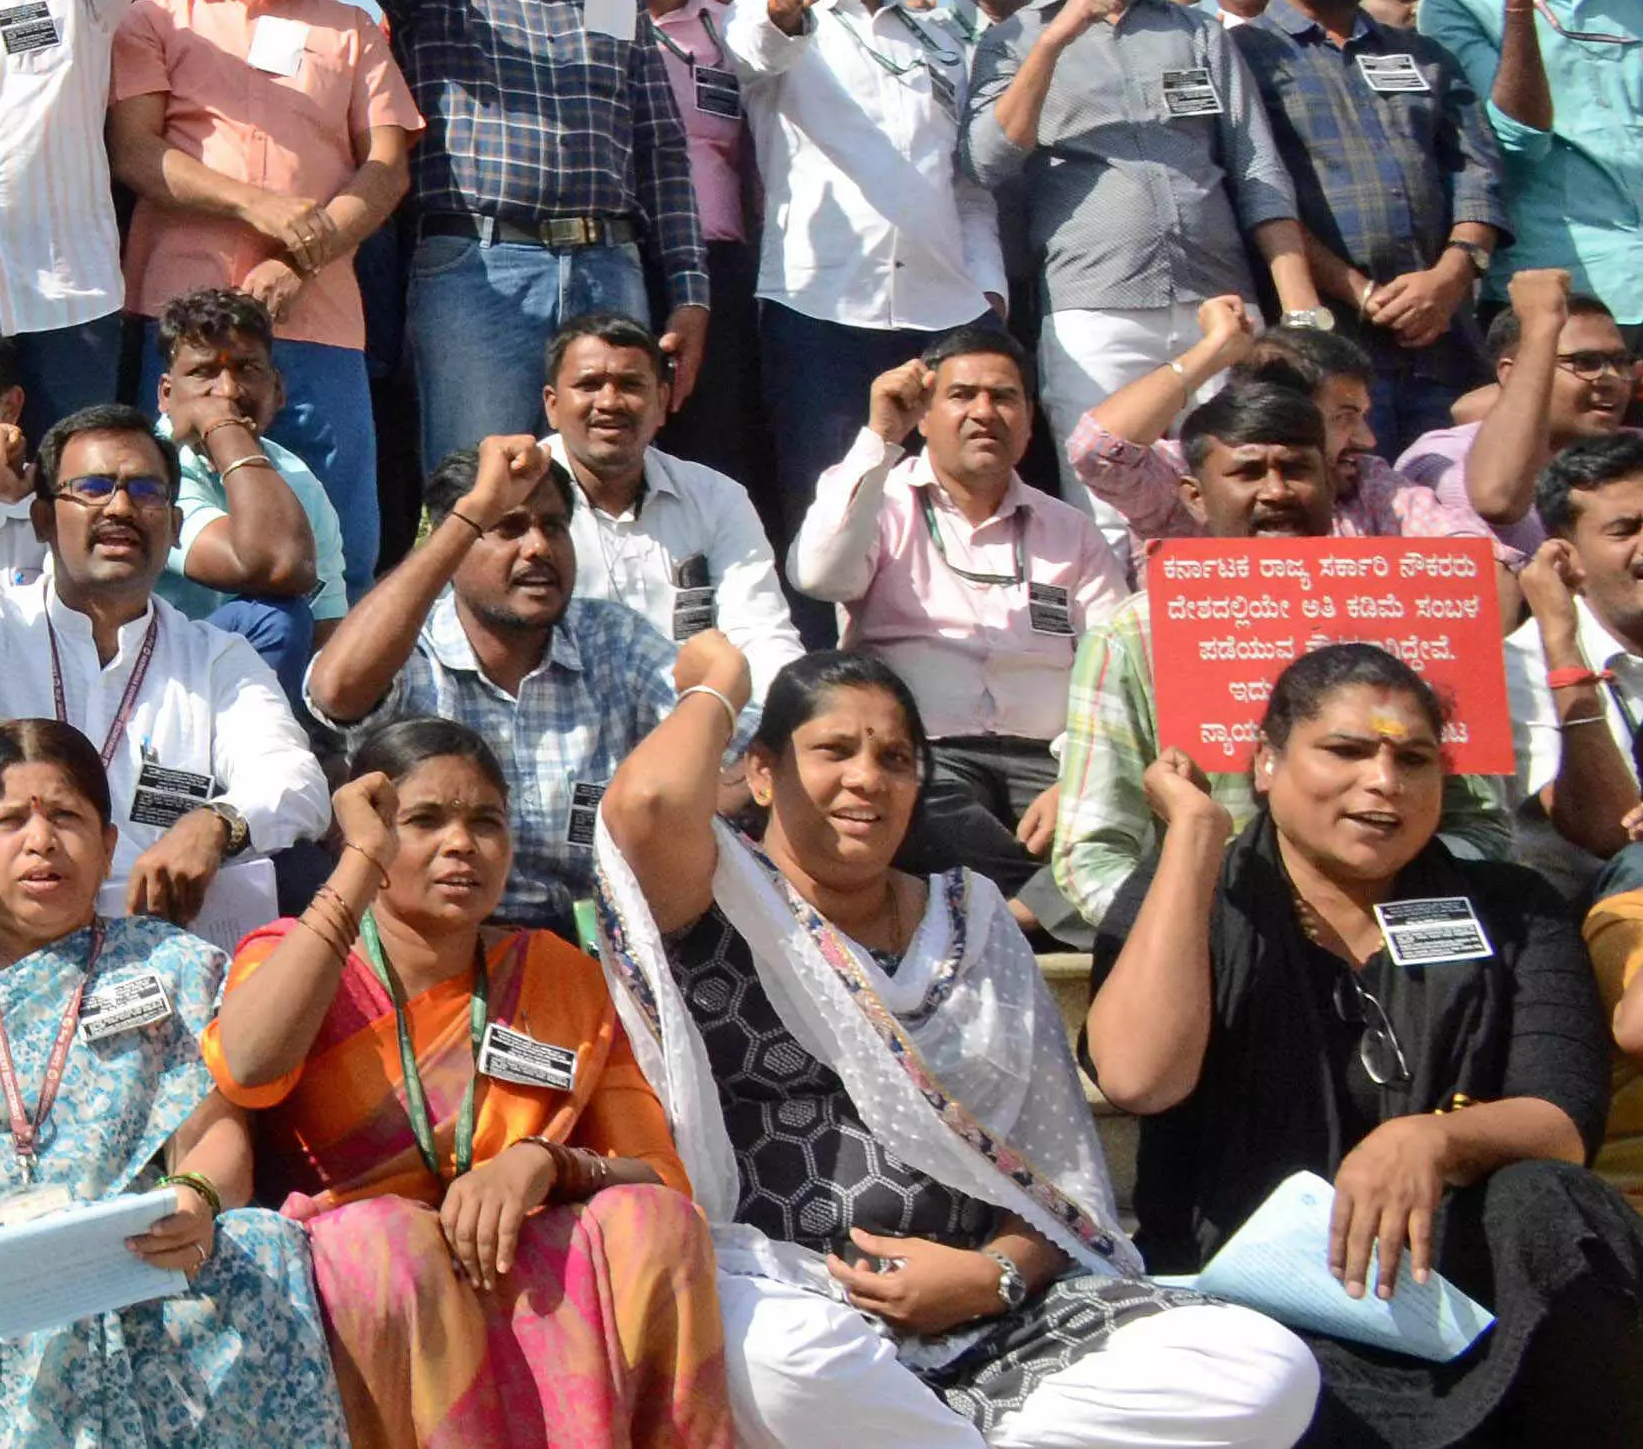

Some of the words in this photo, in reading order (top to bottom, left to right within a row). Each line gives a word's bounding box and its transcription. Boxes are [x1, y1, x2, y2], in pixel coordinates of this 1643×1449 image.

[1163, 554, 1250, 580] ಕರ್ನಾಟಕ
[1259, 557, 1313, 591] ರಾಜ್ಯ
[1319, 554, 1390, 578] ಸರ್ಕಾರಿ
[1398, 551, 1479, 578] ನೌಕರರು
[1167, 594, 1291, 630] ದೇಶದಲ್ಲಿಯೇ
[1301, 595, 1337, 619] ಅತಿ
[1346, 593, 1405, 618] ಕಡಿಮೆ
[1415, 594, 1481, 619] ಸಂಬಳ
[1199, 635, 1295, 661] ಪಡೆಯುವ
